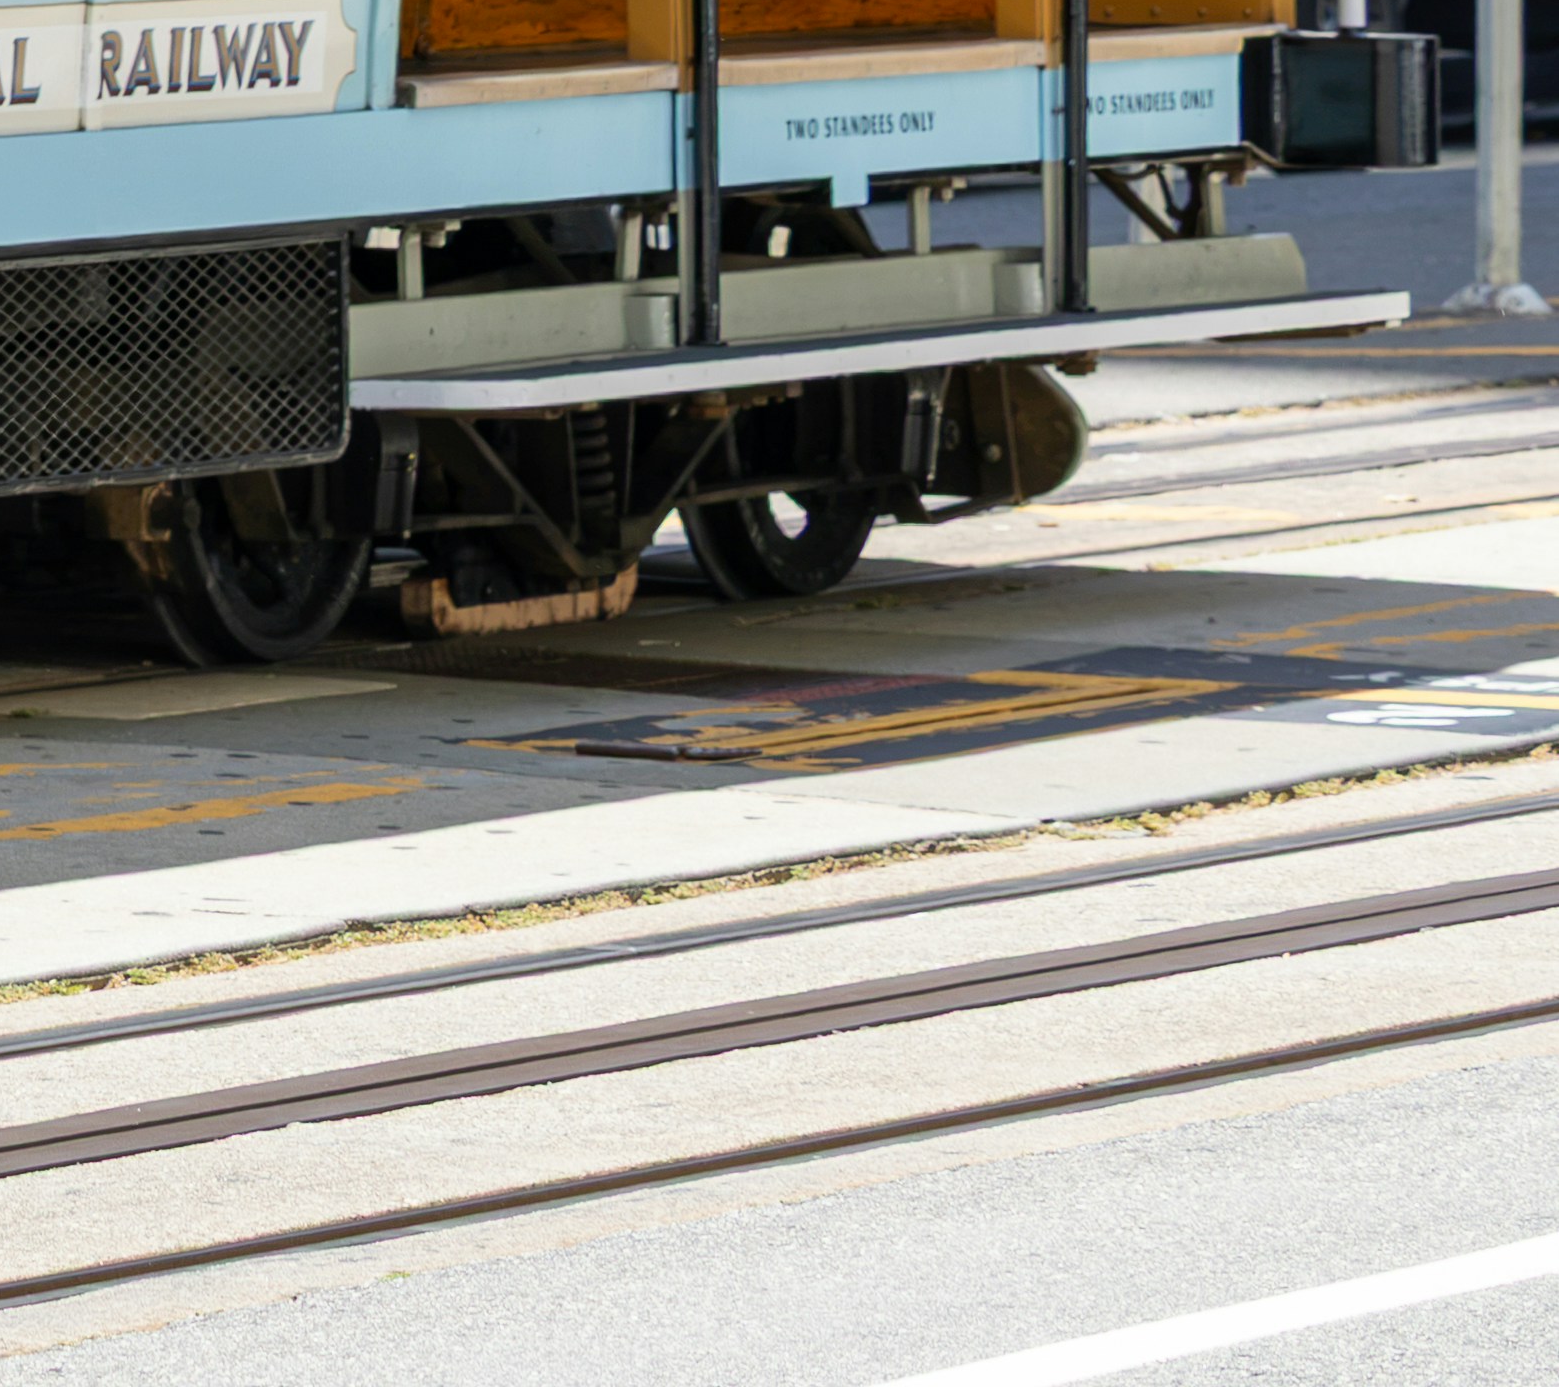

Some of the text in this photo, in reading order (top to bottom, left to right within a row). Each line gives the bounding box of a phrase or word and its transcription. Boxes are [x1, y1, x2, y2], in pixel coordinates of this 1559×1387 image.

[98, 20, 316, 100] RAILWAY
[1111, 91, 1176, 114] STANDEES
[1180, 89, 1214, 110] ONLY
[786, 111, 935, 140] TWO STANDEES ONLY
